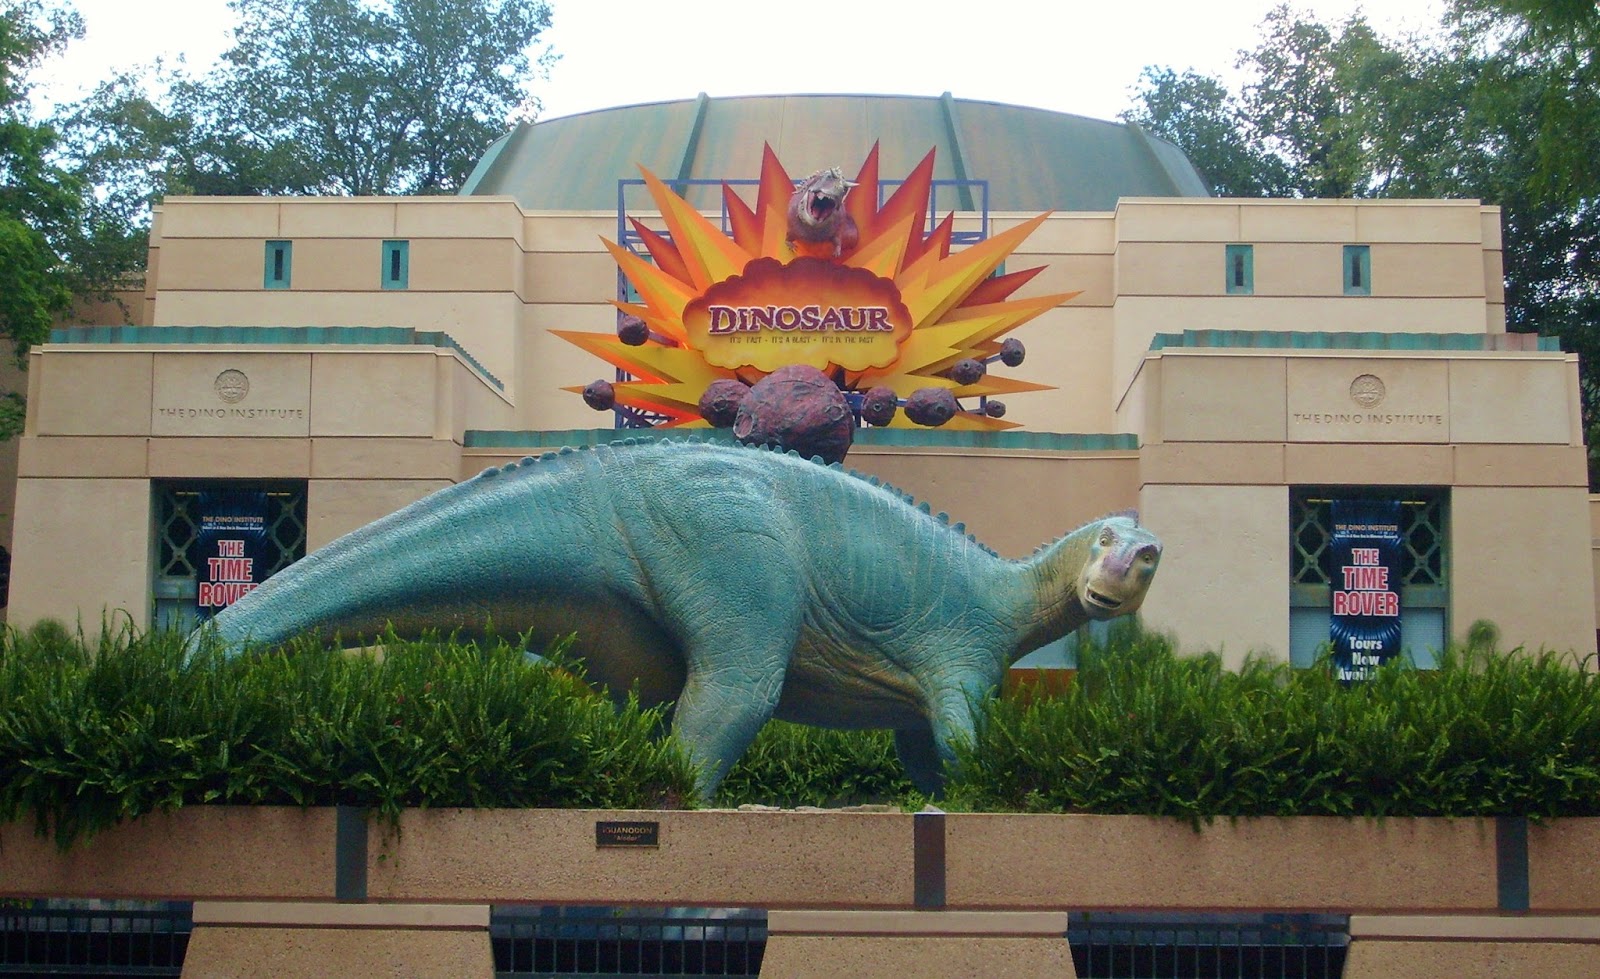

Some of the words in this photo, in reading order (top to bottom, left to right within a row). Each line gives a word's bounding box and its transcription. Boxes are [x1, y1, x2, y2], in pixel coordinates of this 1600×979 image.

[708, 305, 894, 334] DINOSAUR
[159, 408, 184, 418] THE
[188, 408, 226, 419] DINO
[230, 408, 303, 419] INSTITUTE
[1293, 413, 1320, 424] THE
[1324, 414, 1362, 424] DINO
[1367, 414, 1443, 425] INSTITUTE
[234, 516, 264, 524] INSTITUTE
[218, 540, 245, 557] THE
[1352, 548, 1379, 565] THE
[208, 558, 253, 582] TIME
[1342, 566, 1388, 590] TIME
[199, 582, 260, 606] ROVE
[1334, 591, 1398, 616] ROVER
[1350, 636, 1383, 650] Tours
[1352, 652, 1380, 665] Now
